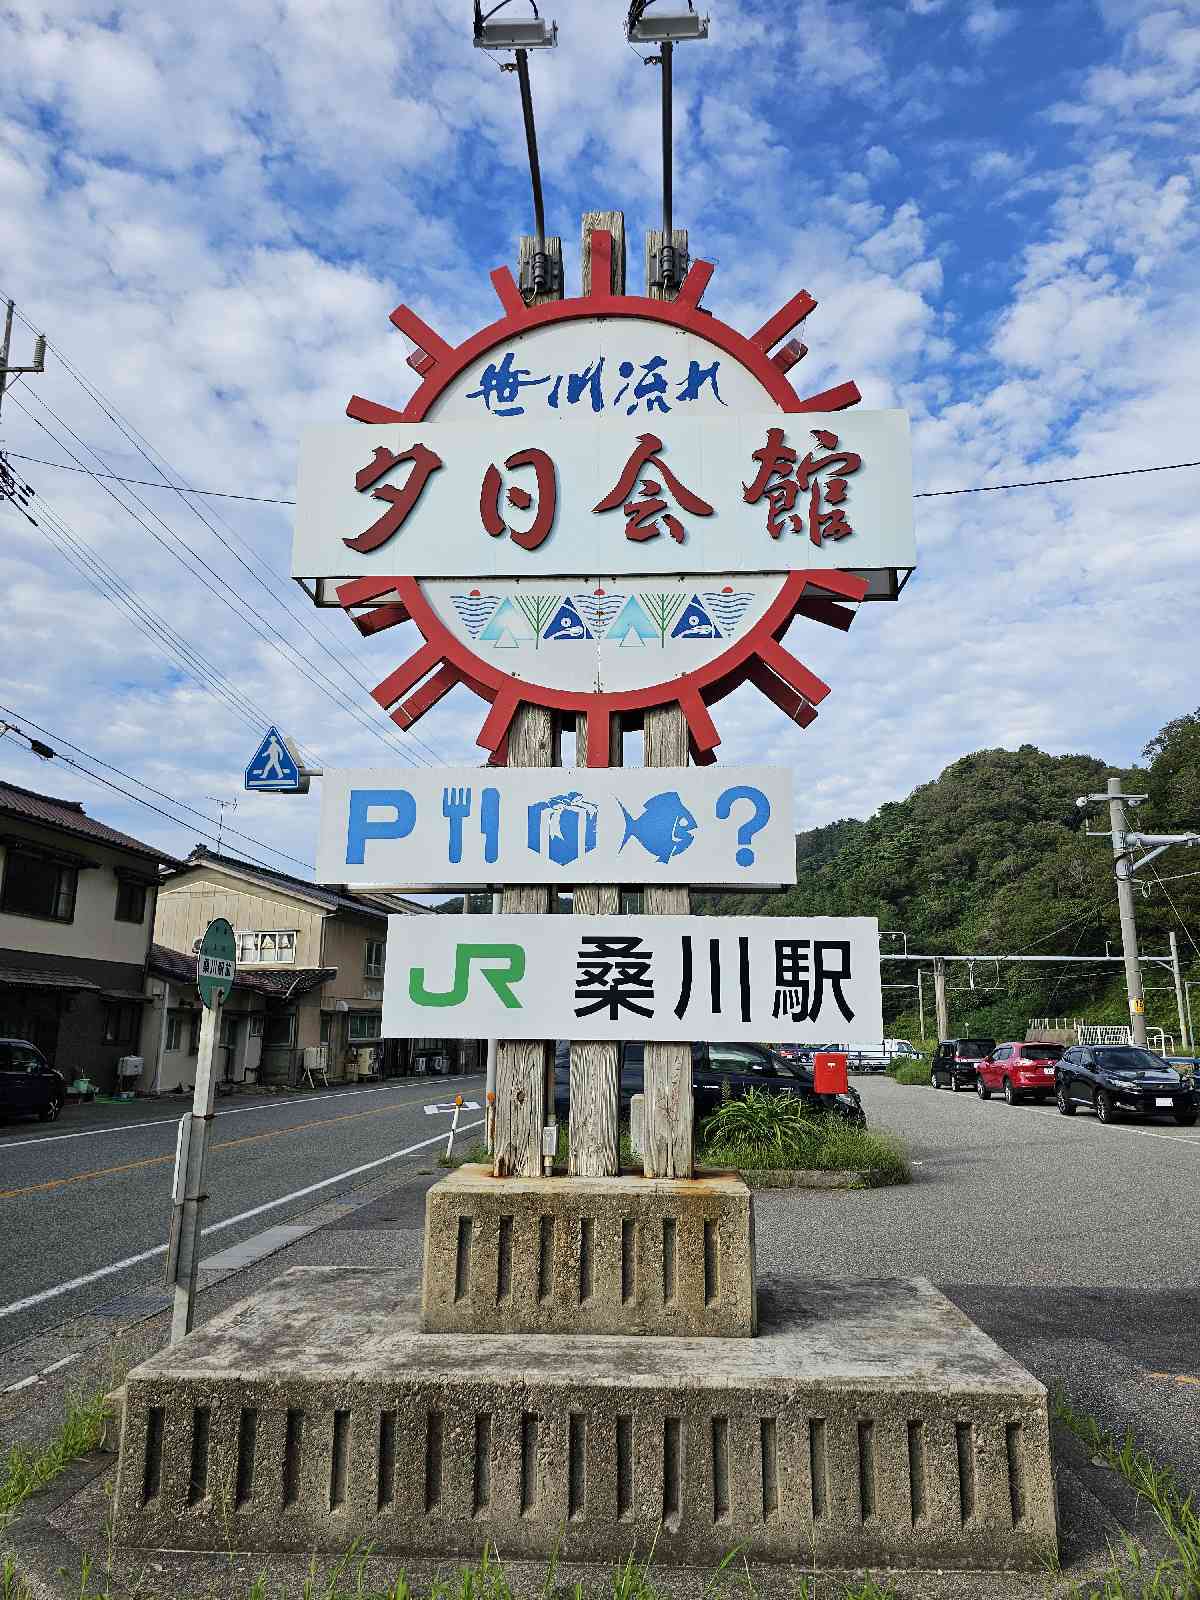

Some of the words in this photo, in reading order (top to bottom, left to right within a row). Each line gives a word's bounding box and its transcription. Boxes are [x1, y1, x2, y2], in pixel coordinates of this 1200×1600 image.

[466, 353, 728, 416] 笹川流れ
[342, 427, 863, 554] 夕日会館
[346, 789, 417, 865] P
[408, 943, 526, 1009] JR
[574, 935, 856, 1023] 桑川駅
